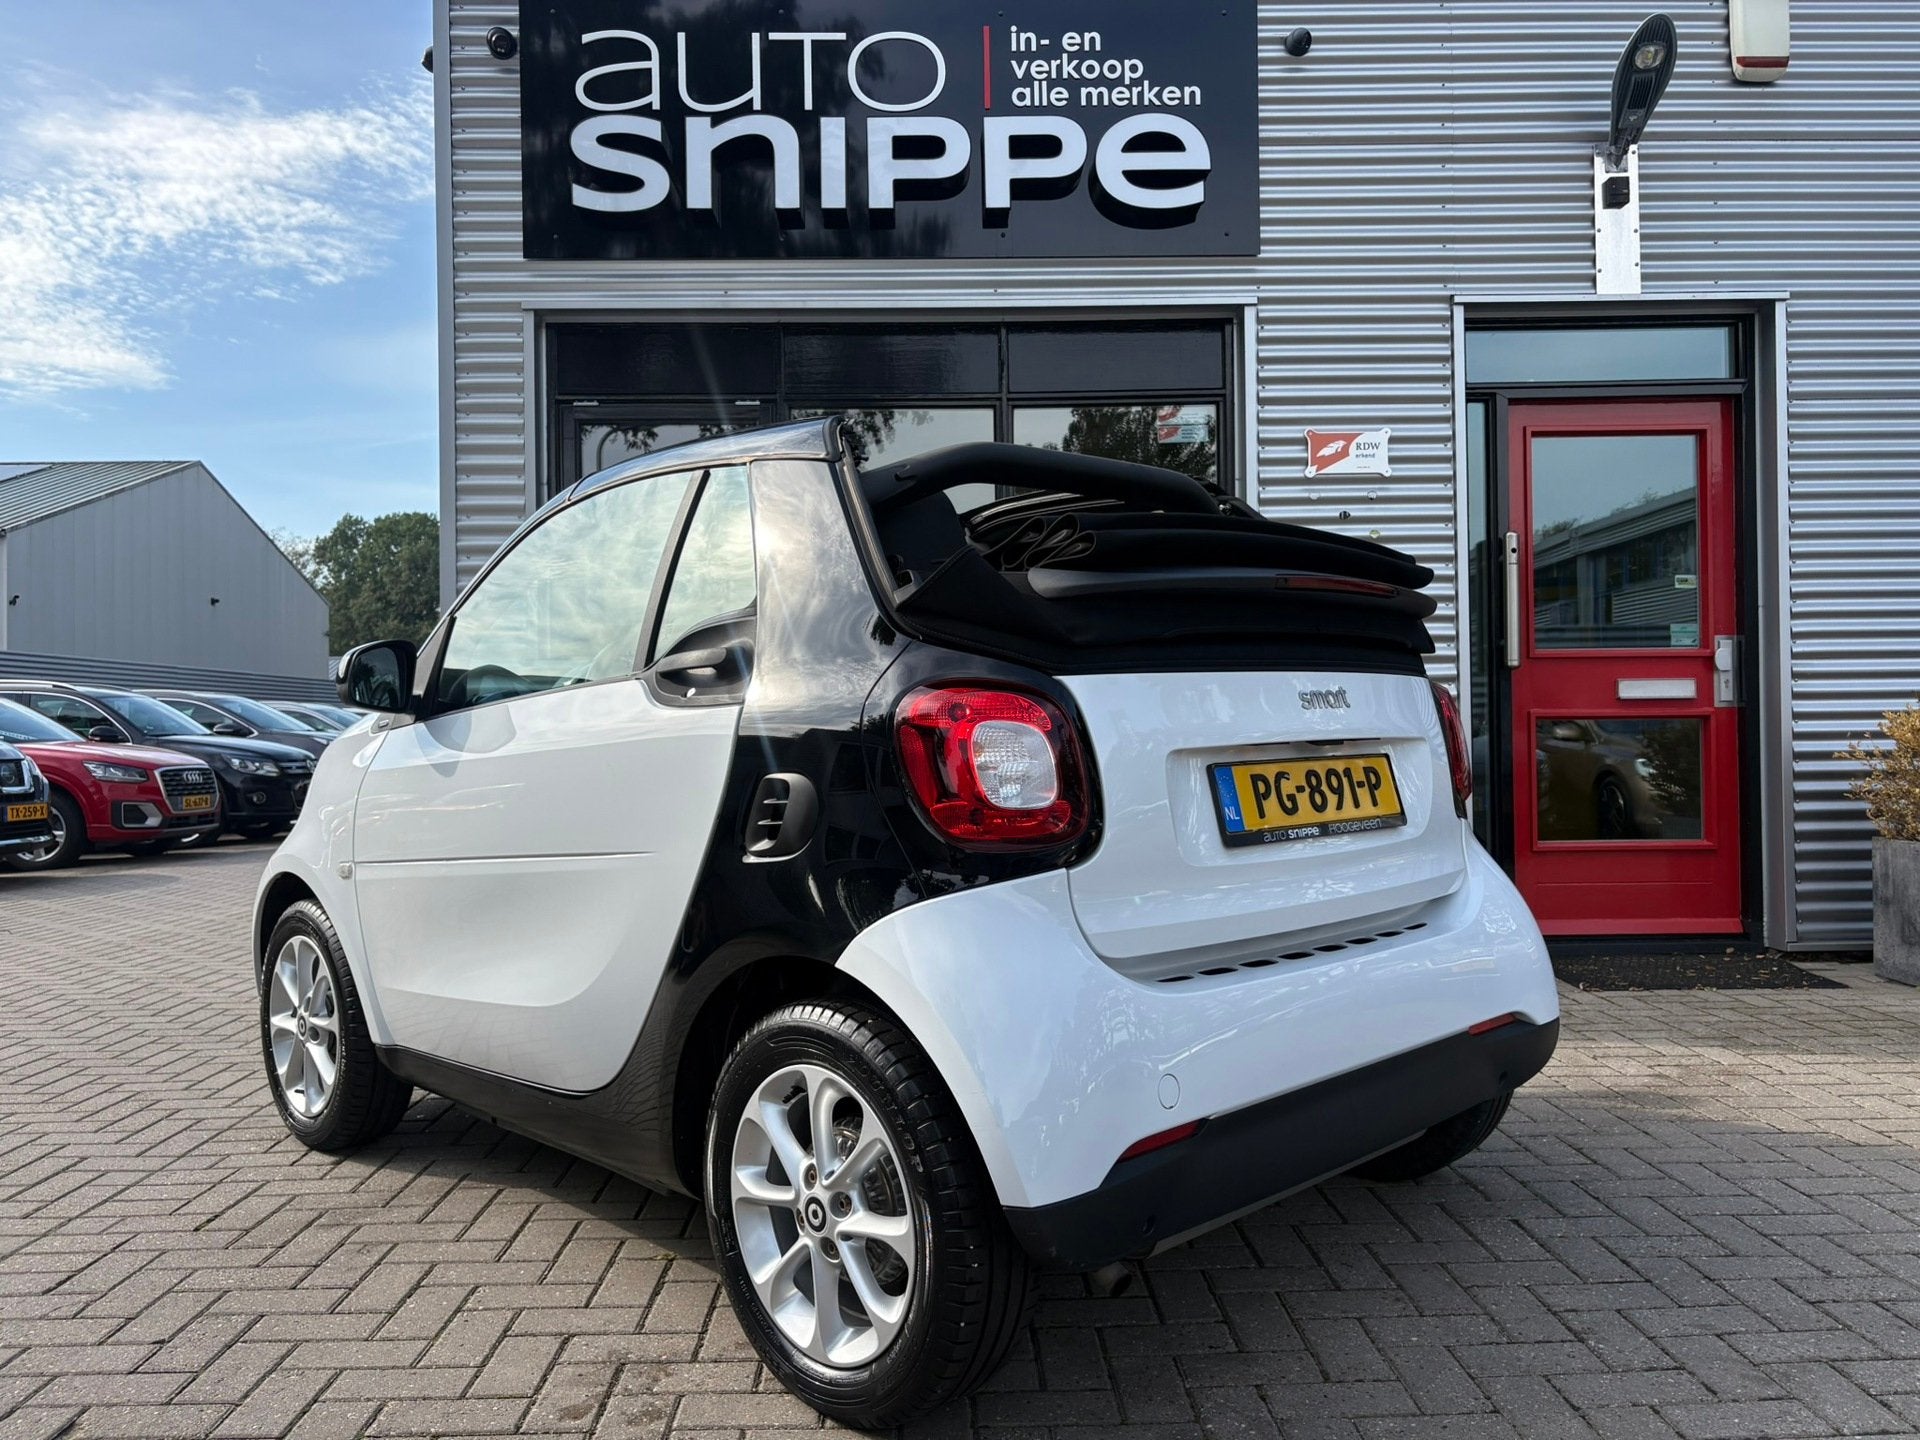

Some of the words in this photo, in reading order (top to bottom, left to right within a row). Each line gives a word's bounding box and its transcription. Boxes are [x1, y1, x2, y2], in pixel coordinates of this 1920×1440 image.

[1009, 25, 1050, 53] in-
[1061, 30, 1102, 53] en
[1010, 54, 1145, 85] verkoop
[1011, 80, 1074, 108] alle
[1079, 80, 1202, 108] merken
[1355, 441, 1381, 451] RDW
[1298, 686, 1351, 710] smart
[1225, 806, 1240, 820] NL
[1249, 766, 1381, 819] PG-891-P
[10, 805, 45, 819] TX-259-X
